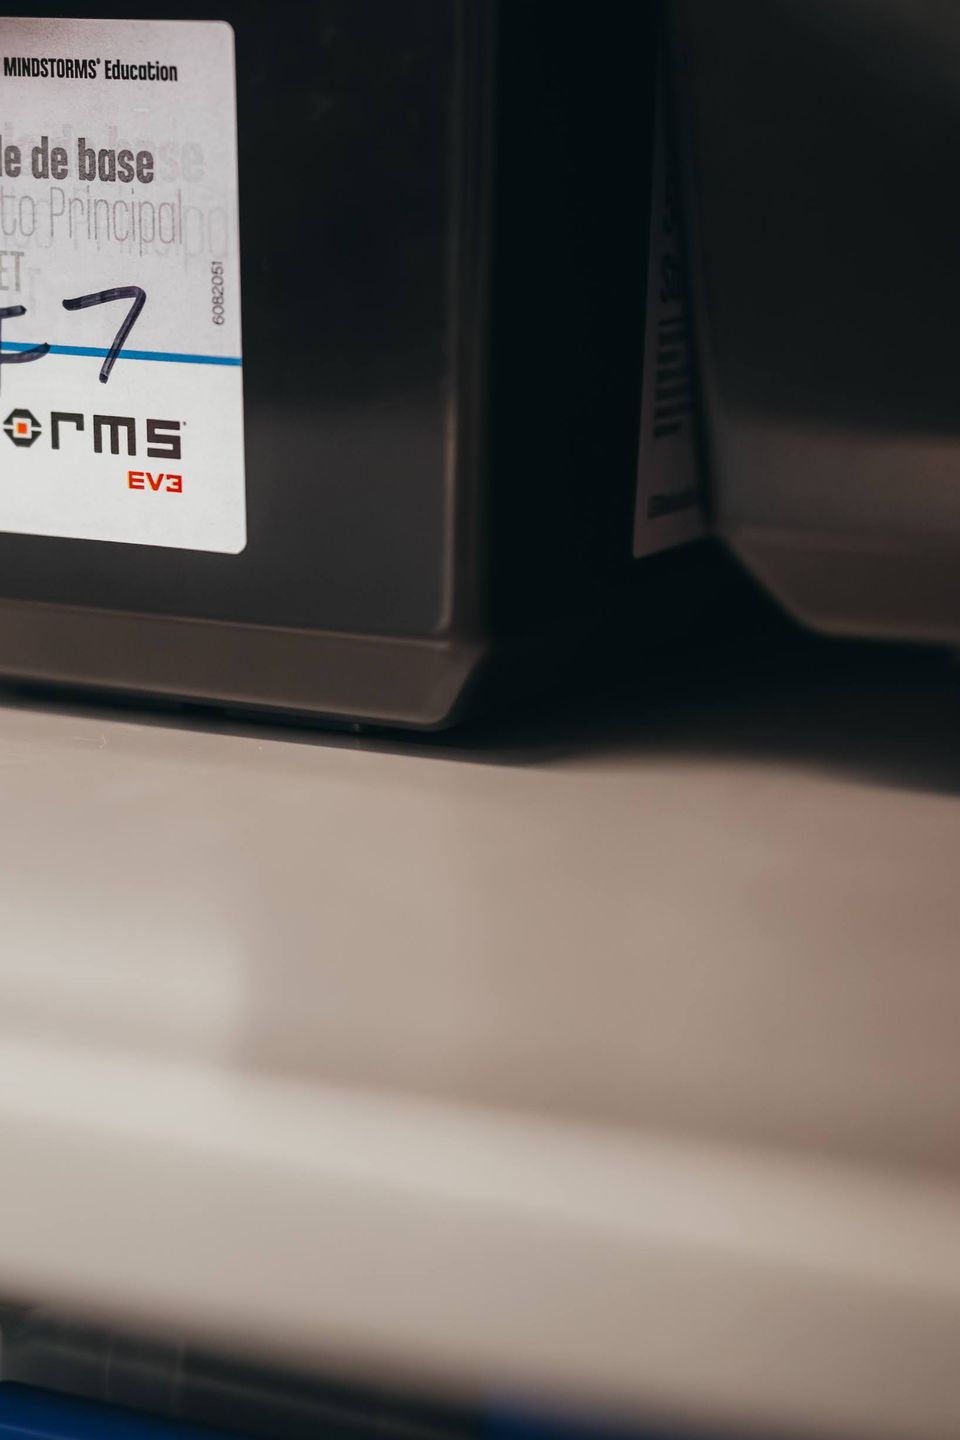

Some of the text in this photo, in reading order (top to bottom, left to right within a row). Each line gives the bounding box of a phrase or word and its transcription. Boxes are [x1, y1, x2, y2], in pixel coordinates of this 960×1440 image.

[105, 60, 178, 82] Education
[31, 136, 68, 180] de
[77, 137, 154, 183] base
[49, 184, 183, 257] Principal
[211, 261, 225, 326] 6082051
[128, 471, 183, 493] EV3
